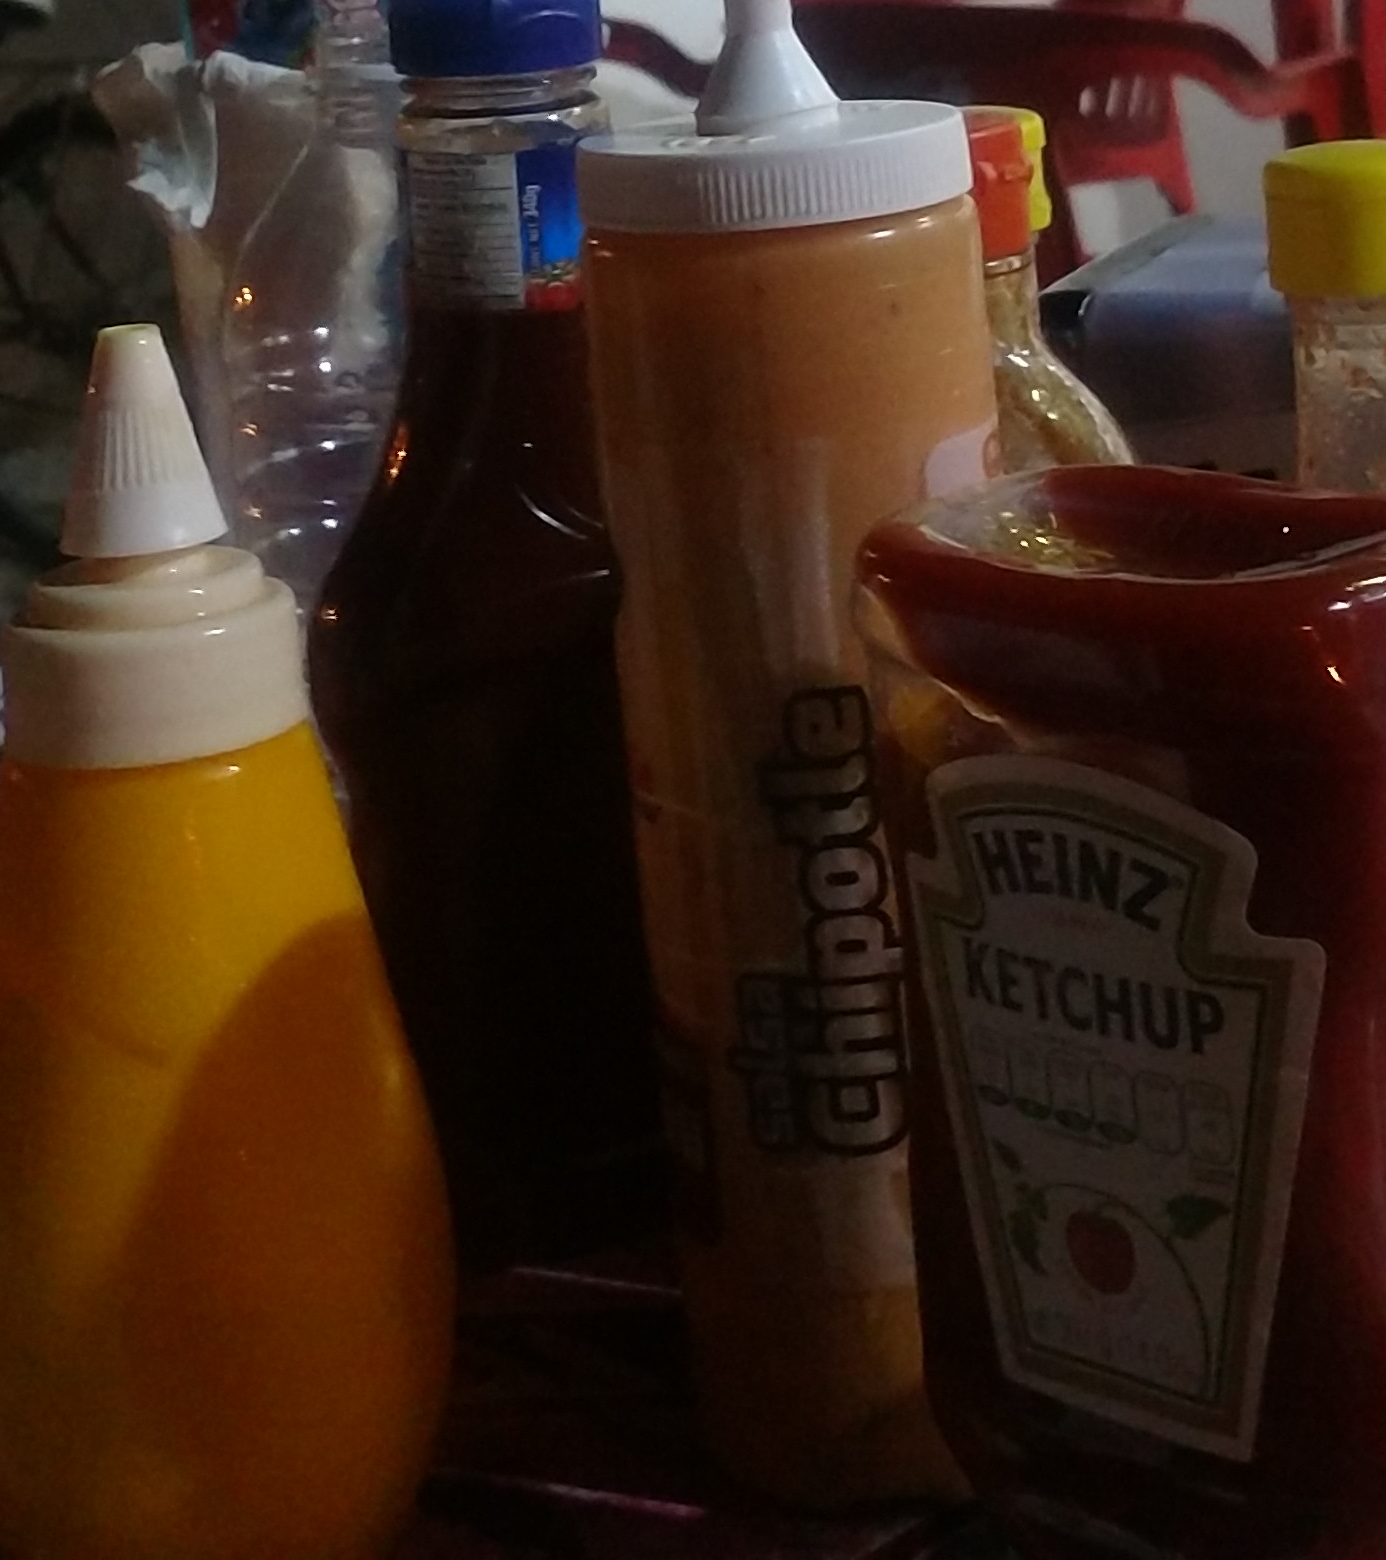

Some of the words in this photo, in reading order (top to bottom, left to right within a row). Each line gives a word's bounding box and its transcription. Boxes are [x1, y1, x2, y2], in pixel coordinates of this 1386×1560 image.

[755, 687, 907, 1154] chipotle
[972, 829, 1169, 932] HEINZ
[962, 936, 1226, 1056] KETCHUP
